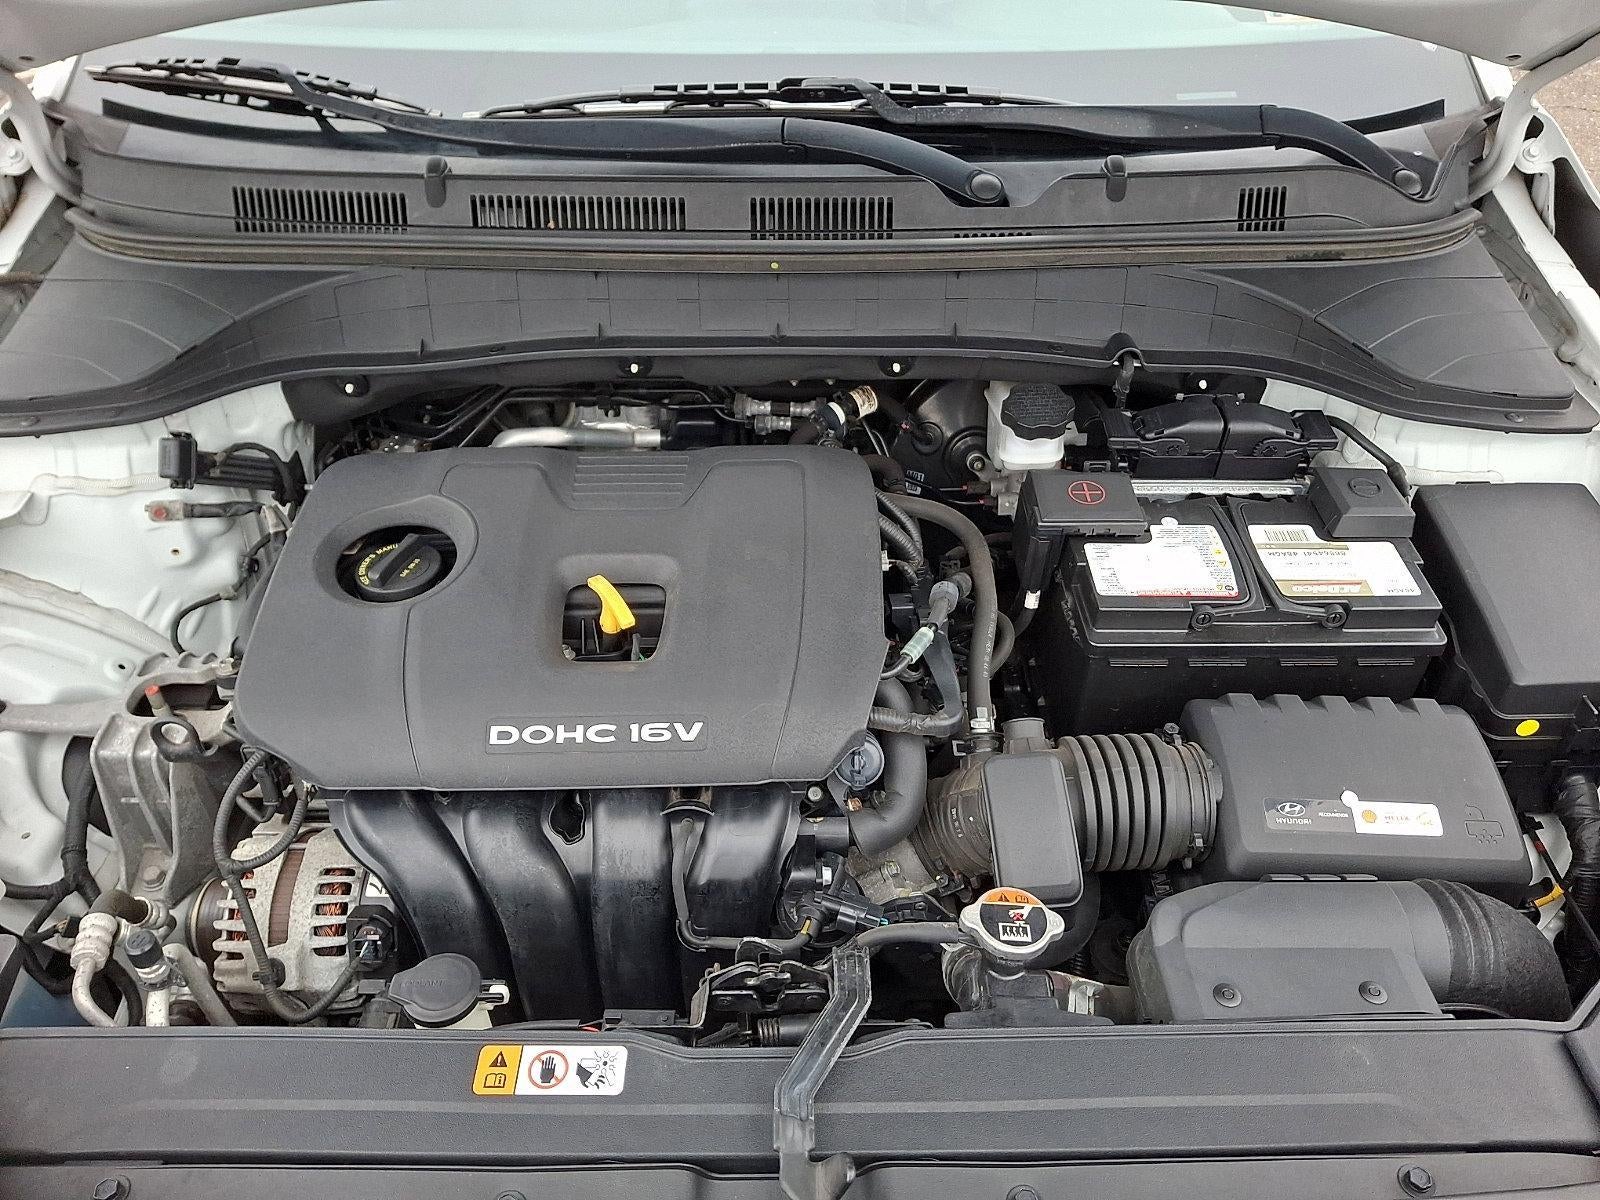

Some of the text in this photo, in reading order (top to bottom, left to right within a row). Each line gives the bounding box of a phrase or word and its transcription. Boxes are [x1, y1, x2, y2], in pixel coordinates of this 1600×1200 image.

[489, 721, 704, 745] DOHC 16V
[1275, 817, 1312, 825] HYUNDAI
